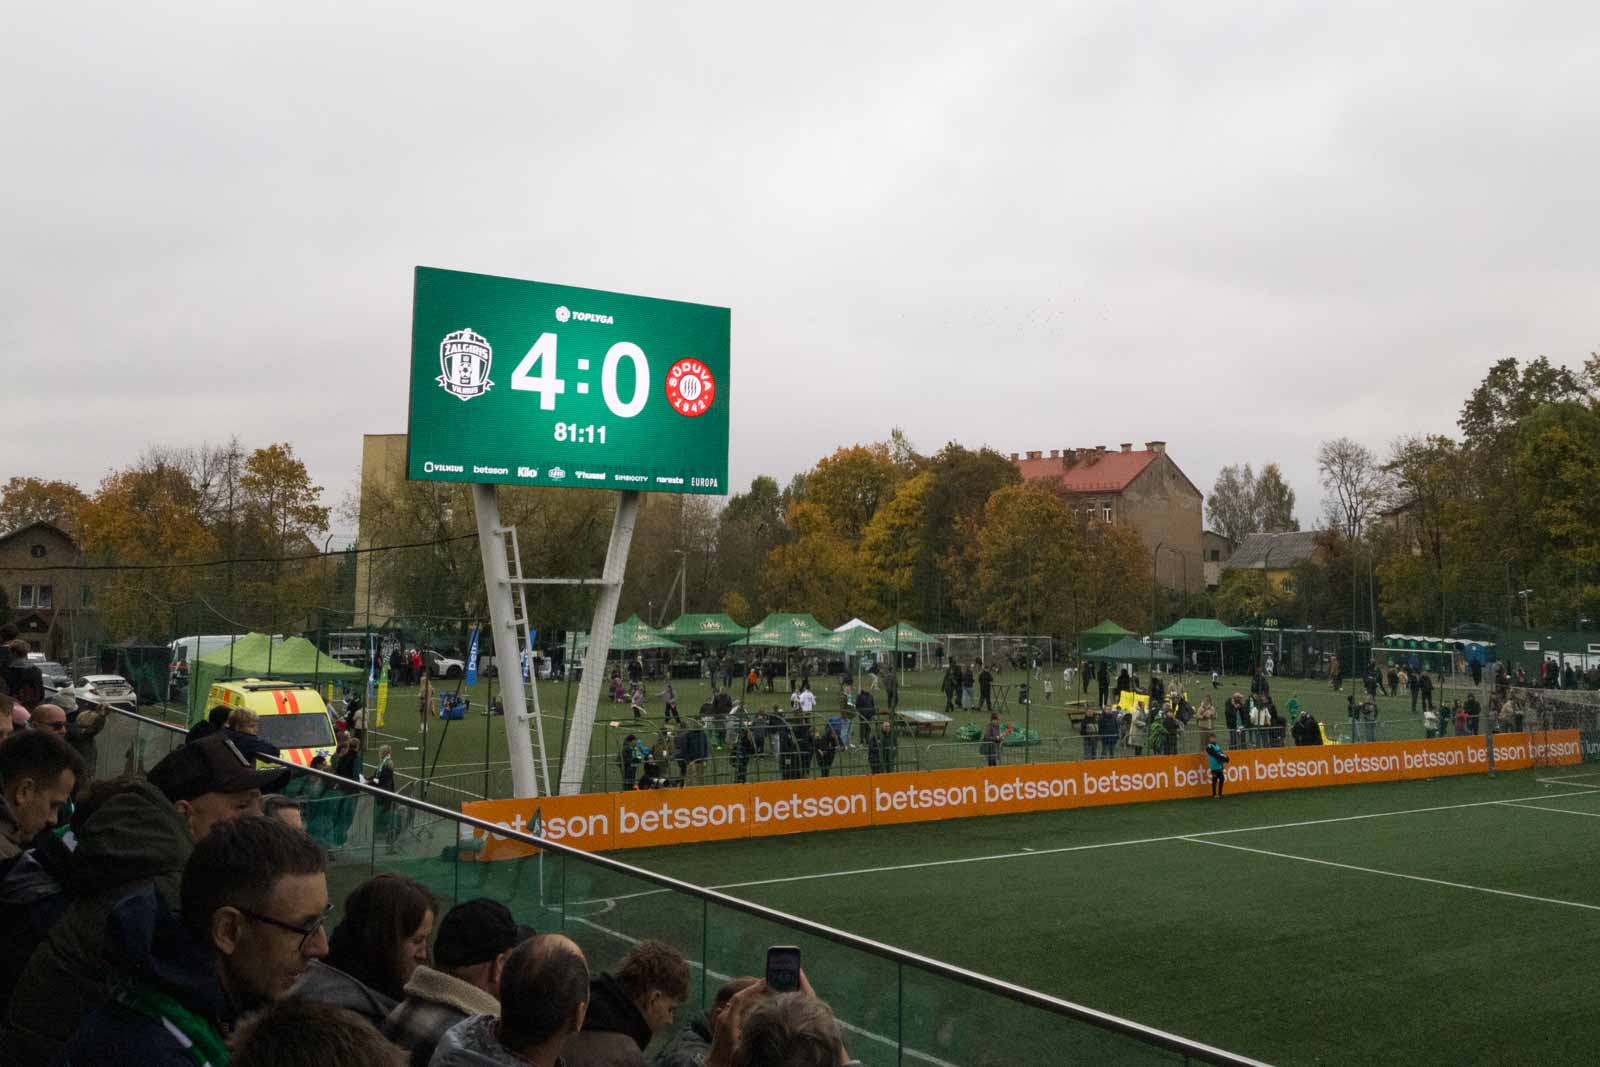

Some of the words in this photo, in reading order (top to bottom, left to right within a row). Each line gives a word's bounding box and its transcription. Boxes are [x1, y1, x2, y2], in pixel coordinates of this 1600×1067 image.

[572, 311, 614, 325] TOPLYGA
[674, 398, 706, 413] 1942
[553, 421, 606, 444] 81:11
[434, 464, 464, 473] VILNIUS
[473, 465, 509, 476] betsson
[517, 466, 538, 478] Kilo
[691, 477, 718, 488] EUROPA
[1333, 754, 1399, 774] betsson
[1404, 750, 1464, 769] betsson
[1467, 746, 1526, 763] besson
[1255, 758, 1328, 779] betsson
[984, 777, 1077, 802] betsson
[1083, 770, 1168, 794] betsson
[755, 793, 867, 822] betsson
[875, 785, 977, 812] betsson
[470, 813, 608, 842] etson
[620, 803, 745, 833] betsson
